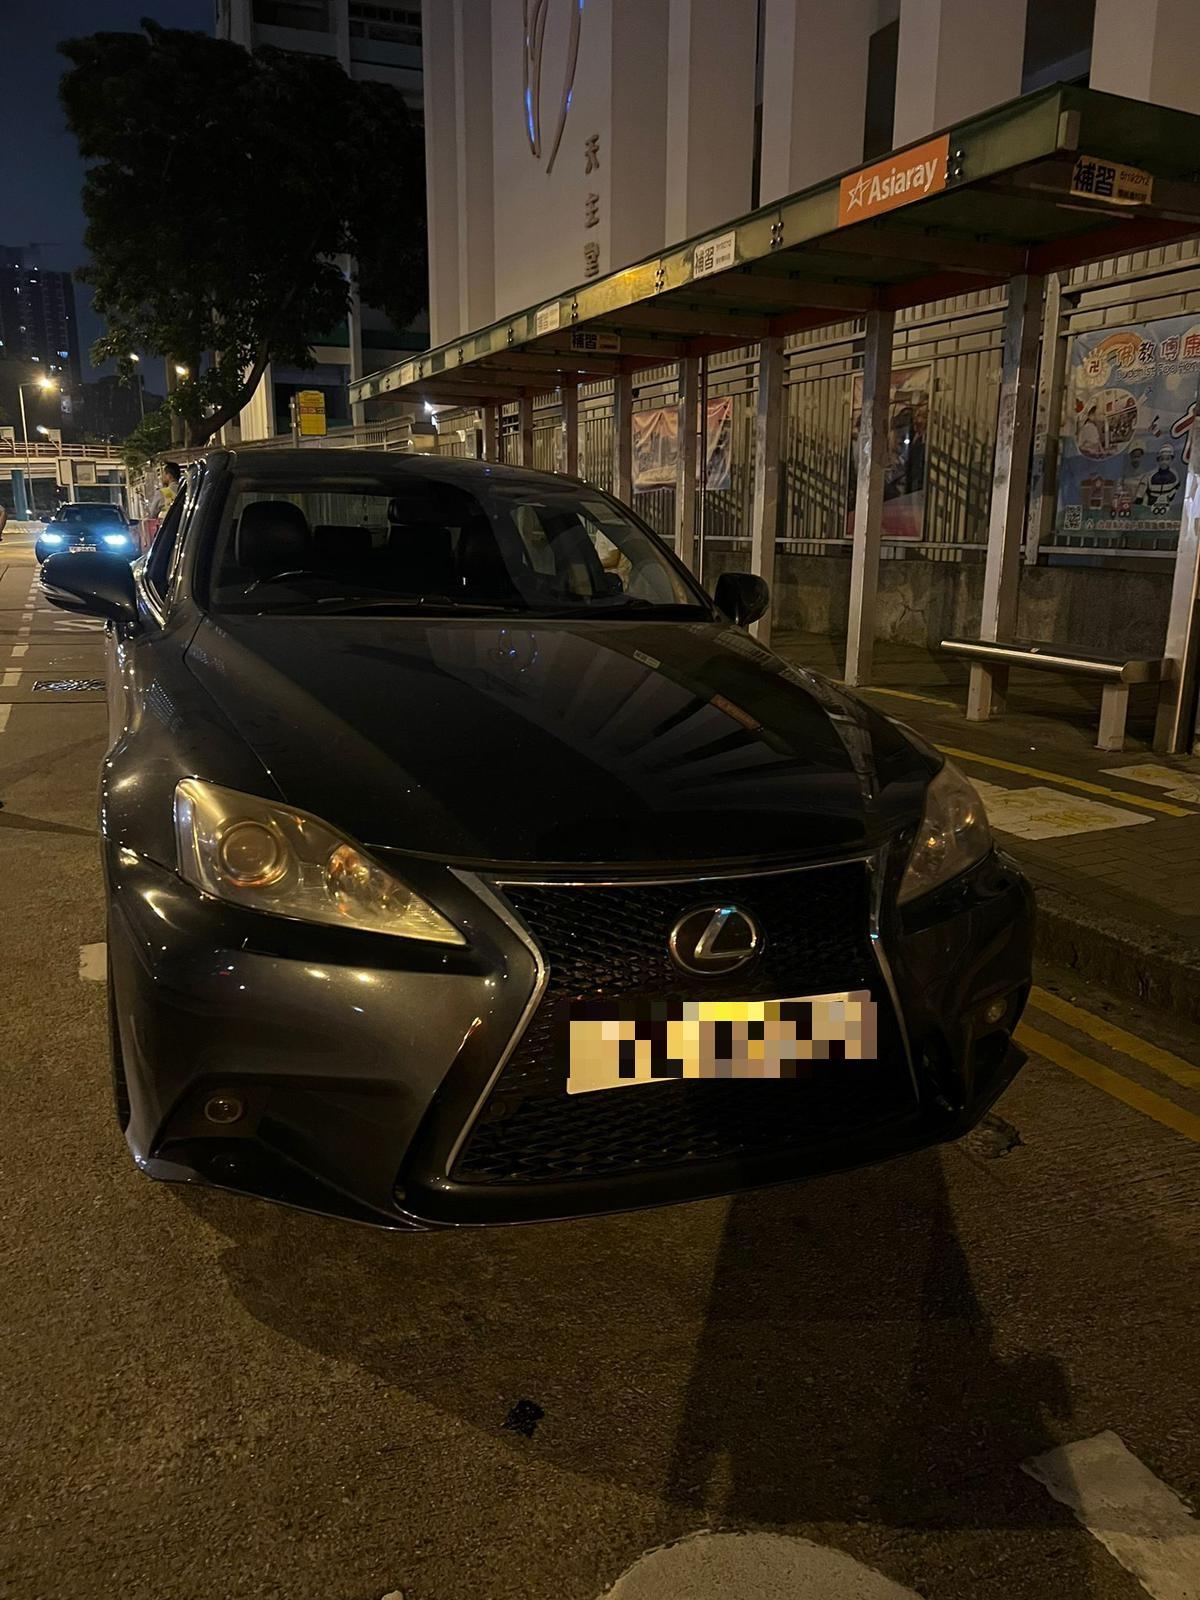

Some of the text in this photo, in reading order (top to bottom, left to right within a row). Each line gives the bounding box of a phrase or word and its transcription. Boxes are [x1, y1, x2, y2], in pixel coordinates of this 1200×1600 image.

[867, 157, 939, 205] Asiaray
[1074, 159, 1116, 197] 補習
[573, 333, 597, 350] 補習
